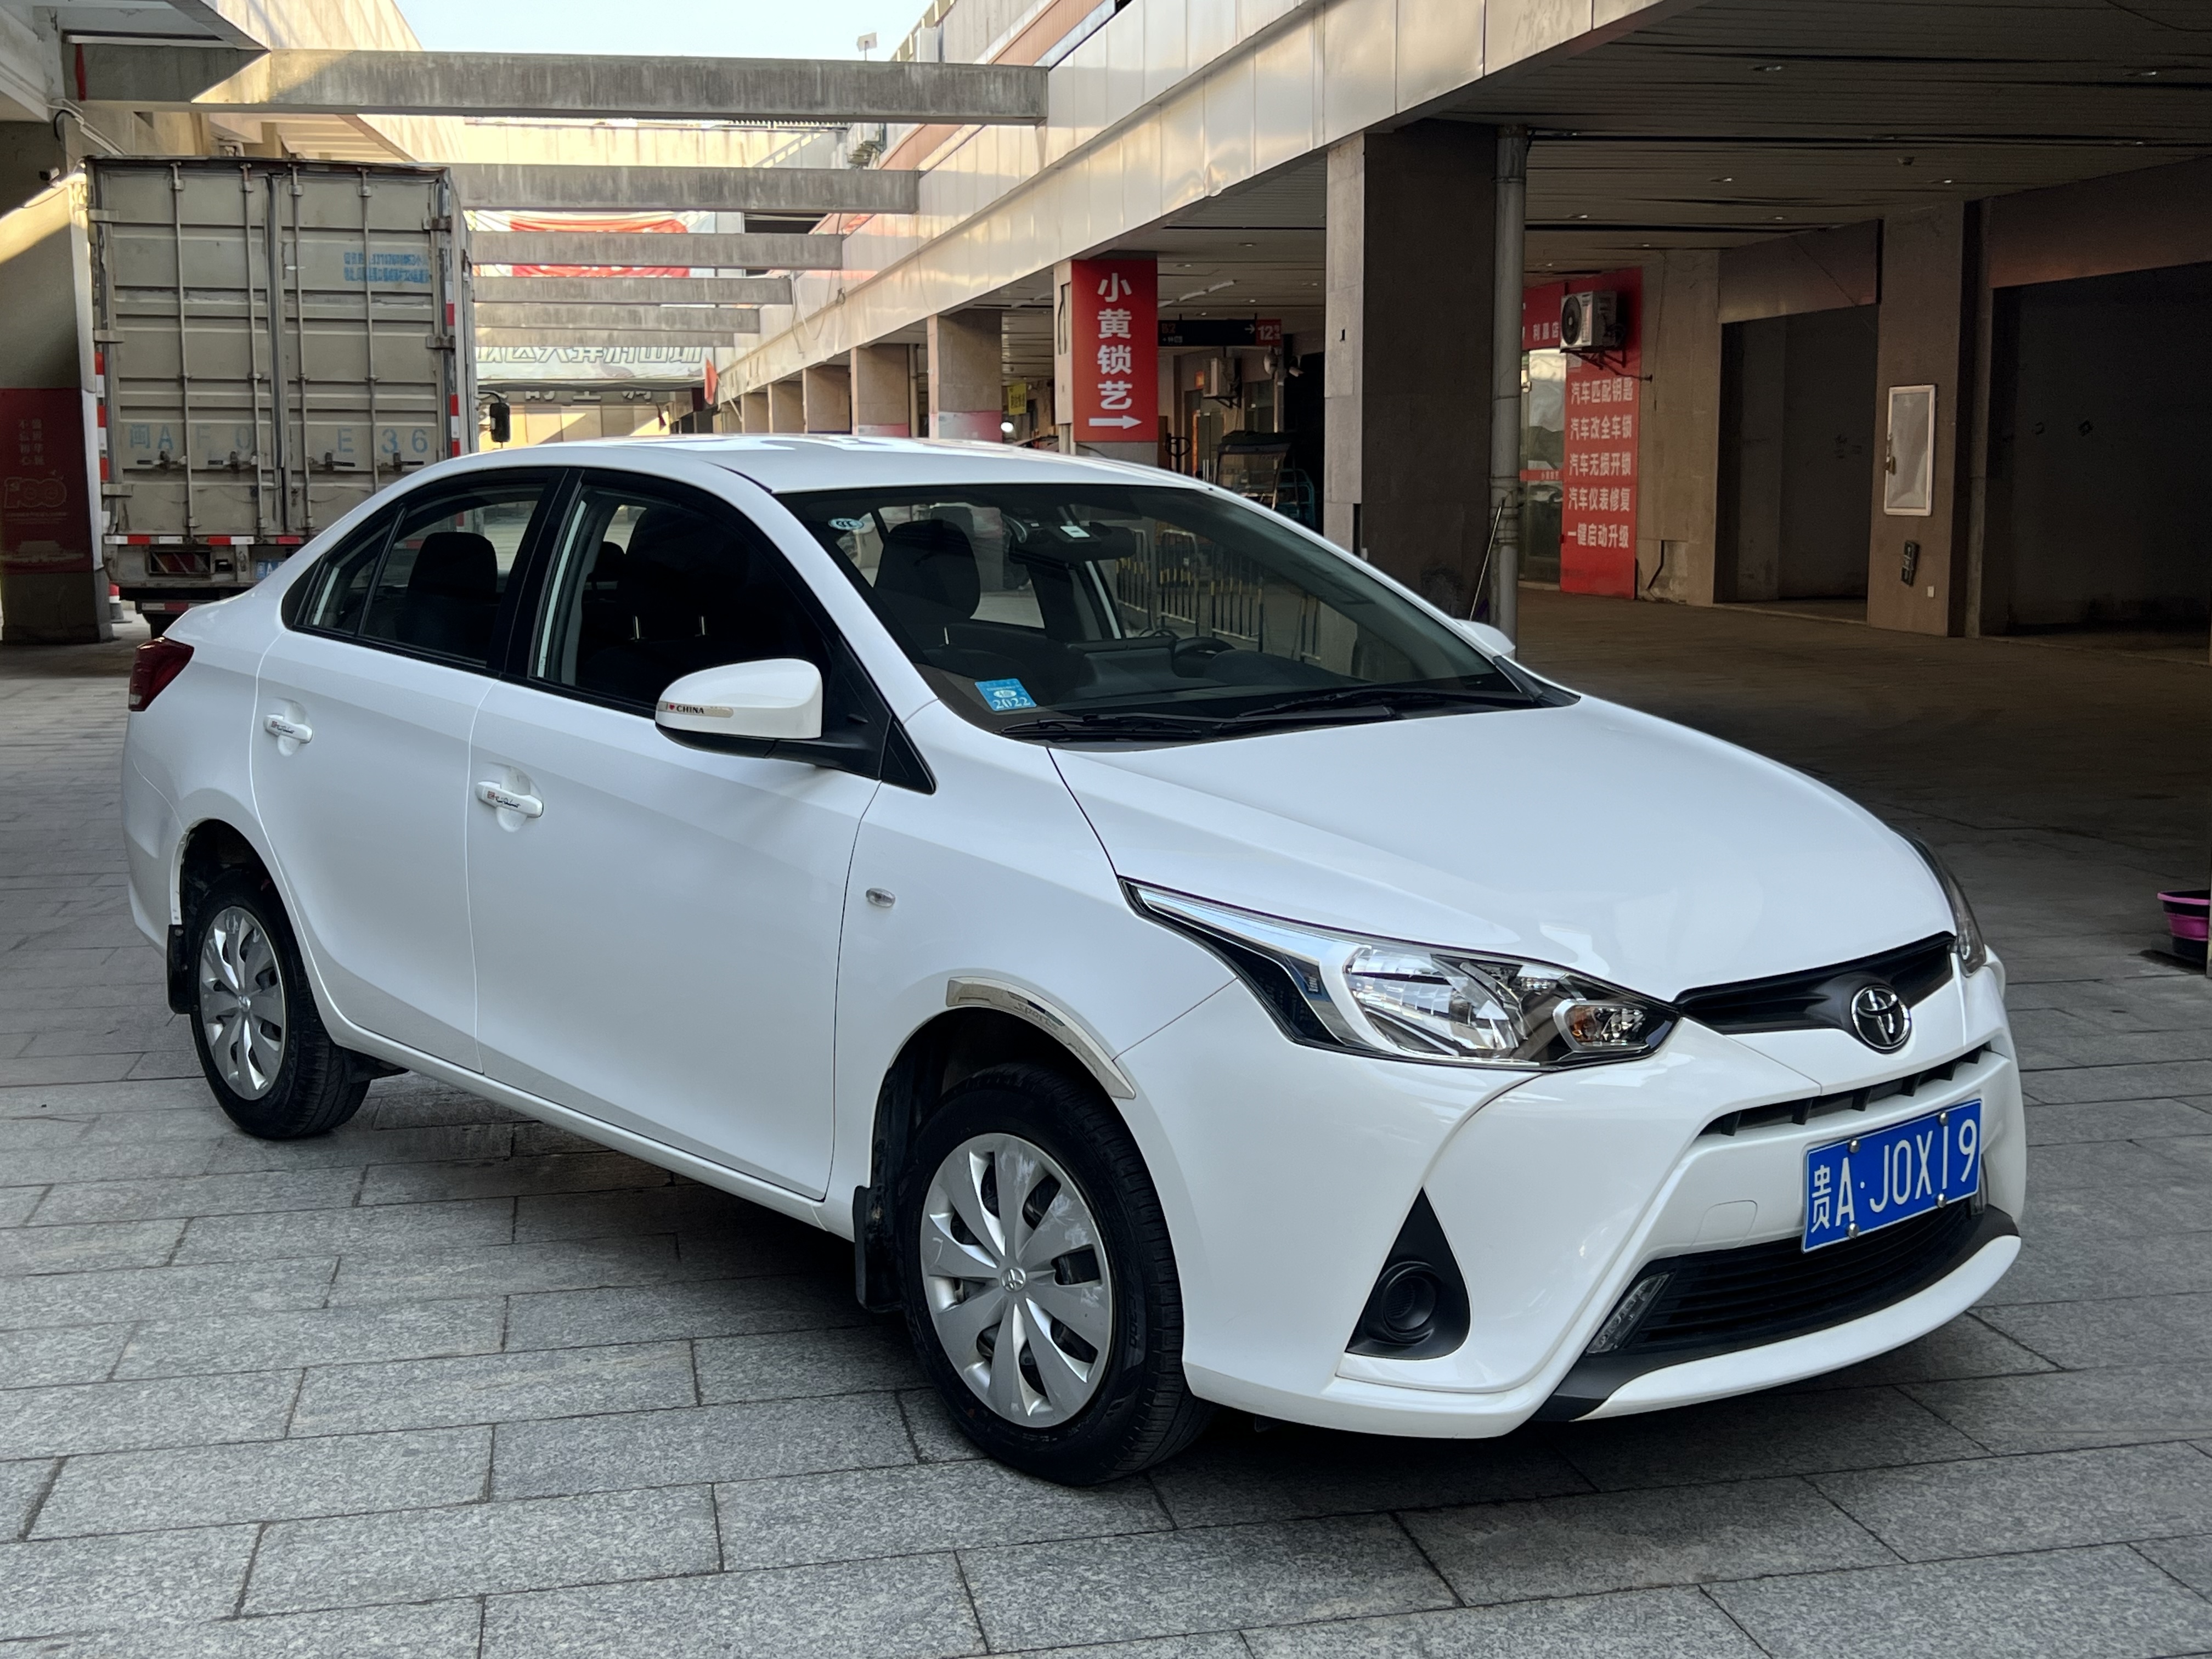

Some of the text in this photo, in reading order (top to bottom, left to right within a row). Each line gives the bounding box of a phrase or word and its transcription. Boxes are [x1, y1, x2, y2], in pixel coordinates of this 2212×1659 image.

[1097, 273, 1133, 410] 小黄锁艺
[1571, 377, 1633, 405] 汽车匹配钥匙
[1570, 414, 1632, 441] 汽车改全车锁
[1568, 452, 1631, 477] 汽车无损开锁
[1568, 487, 1630, 512] 汽车仪表修复
[1567, 522, 1629, 549] 一键启动升级
[676, 705, 704, 714] CHINA
[992, 697, 1031, 709] 2022
